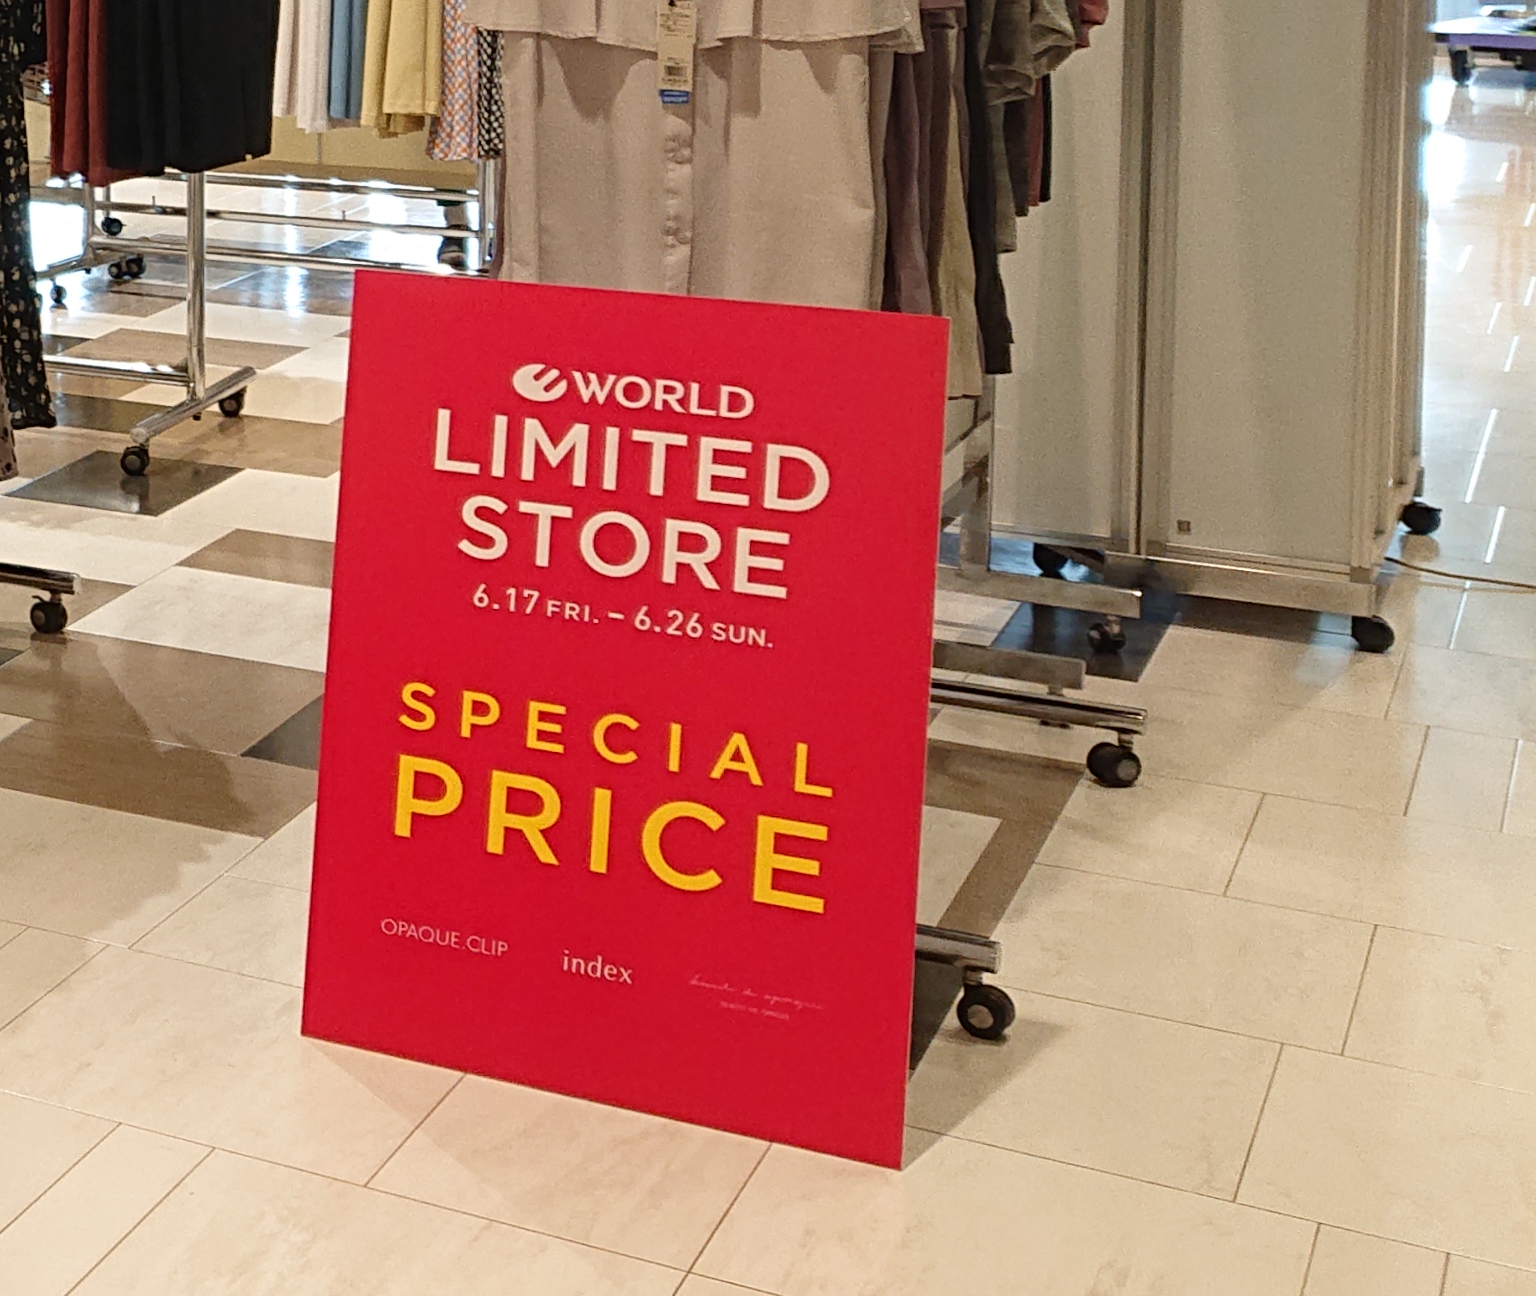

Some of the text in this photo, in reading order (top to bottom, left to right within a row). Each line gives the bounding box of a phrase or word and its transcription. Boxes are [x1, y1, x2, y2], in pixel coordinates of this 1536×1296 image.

[571, 370, 756, 420] WORLD
[433, 407, 830, 513] LIMITED
[456, 494, 791, 599] STORE
[472, 583, 542, 615] 6.17
[546, 598, 600, 625] FRI.
[633, 605, 704, 639] 6.26
[711, 621, 775, 649] SUN.
[398, 681, 834, 798] SPECIAL
[394, 753, 829, 915] PRICE
[561, 949, 635, 986] index
